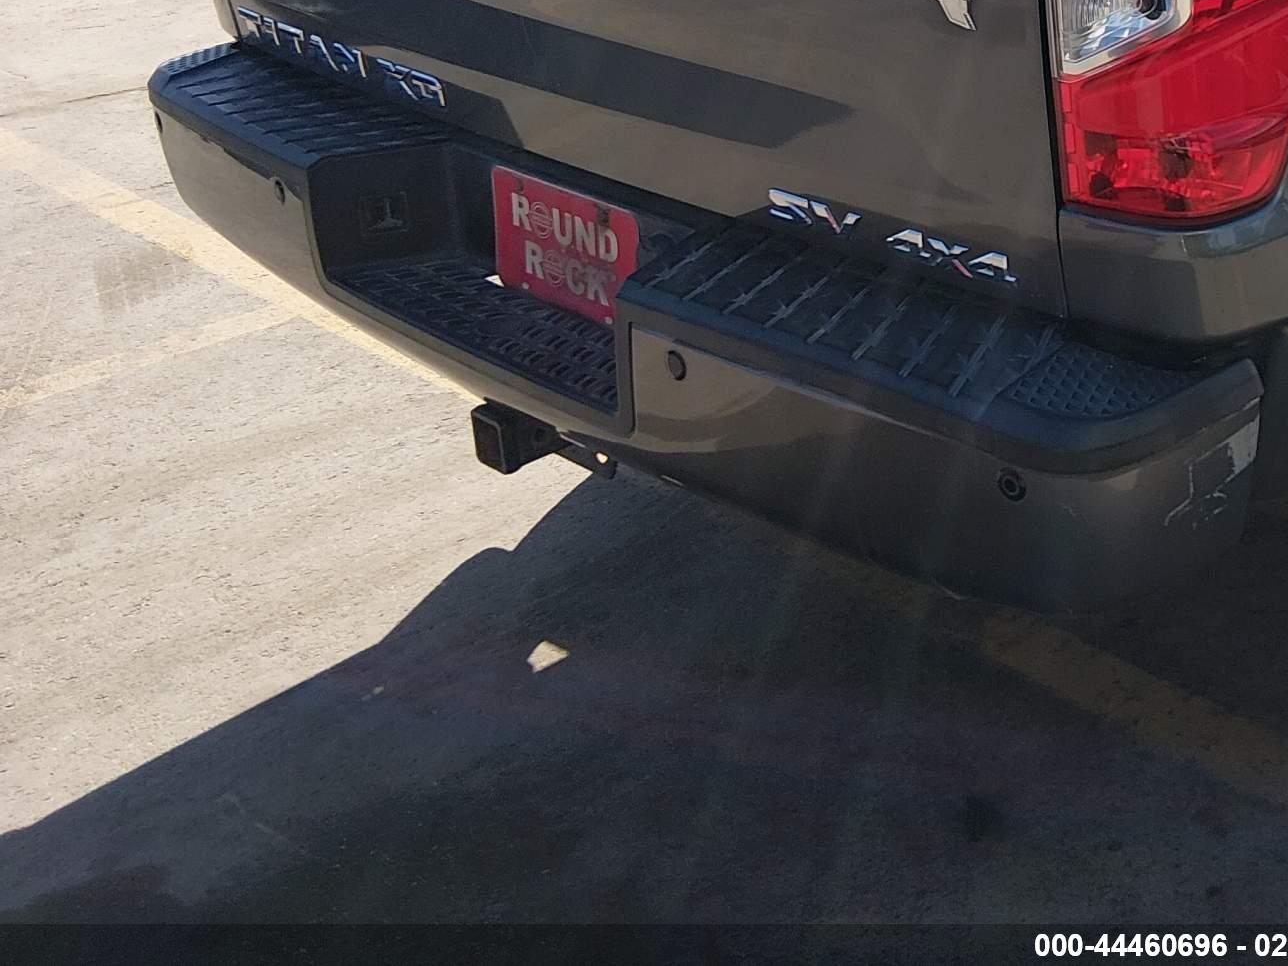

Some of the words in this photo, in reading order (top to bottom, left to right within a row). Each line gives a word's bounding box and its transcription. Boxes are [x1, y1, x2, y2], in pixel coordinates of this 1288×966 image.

[238, 6, 367, 78] TITAN
[511, 192, 618, 263] ROUND
[768, 187, 862, 235] SV
[525, 240, 613, 307] ROCK
